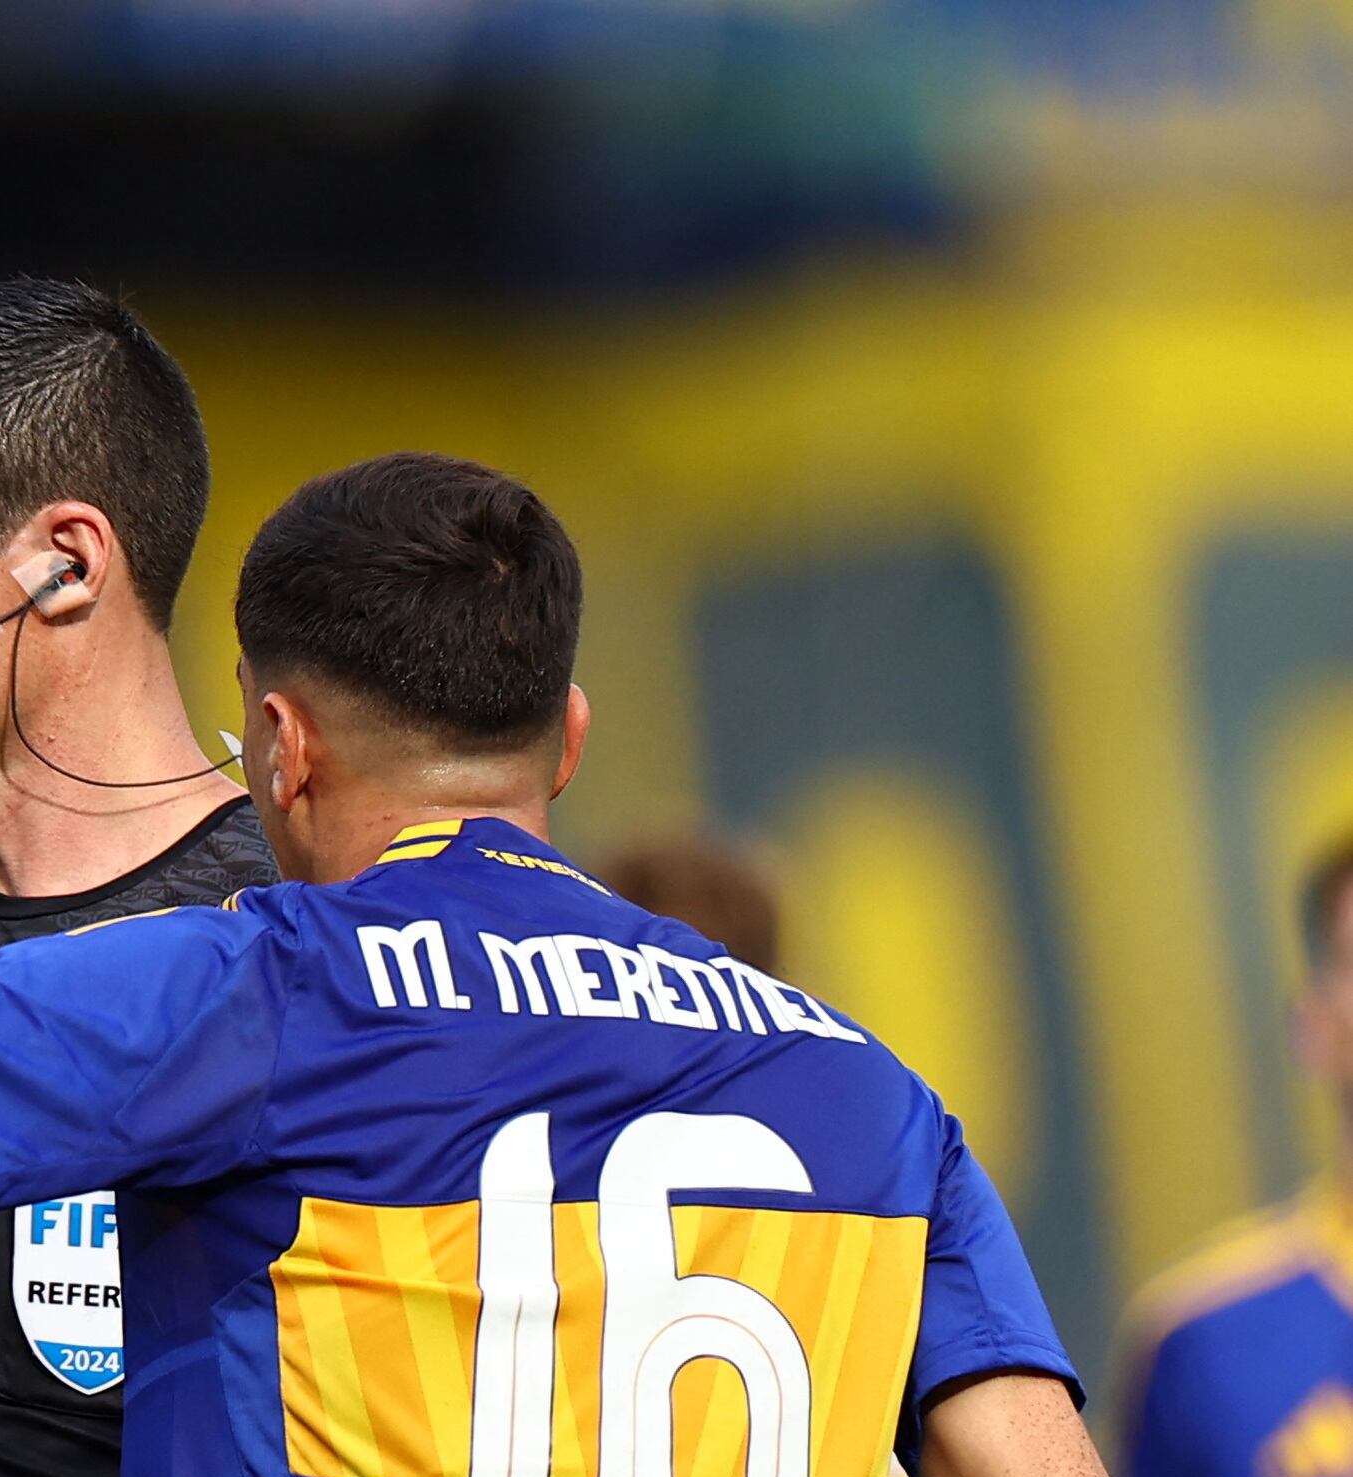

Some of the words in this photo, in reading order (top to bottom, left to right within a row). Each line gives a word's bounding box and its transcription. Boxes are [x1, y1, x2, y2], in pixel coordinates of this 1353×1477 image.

[356, 919, 472, 1010] M.
[478, 931, 869, 1045] MERENTIEL
[30, 1200, 120, 1249] FIF
[59, 1349, 121, 1374] 2024
